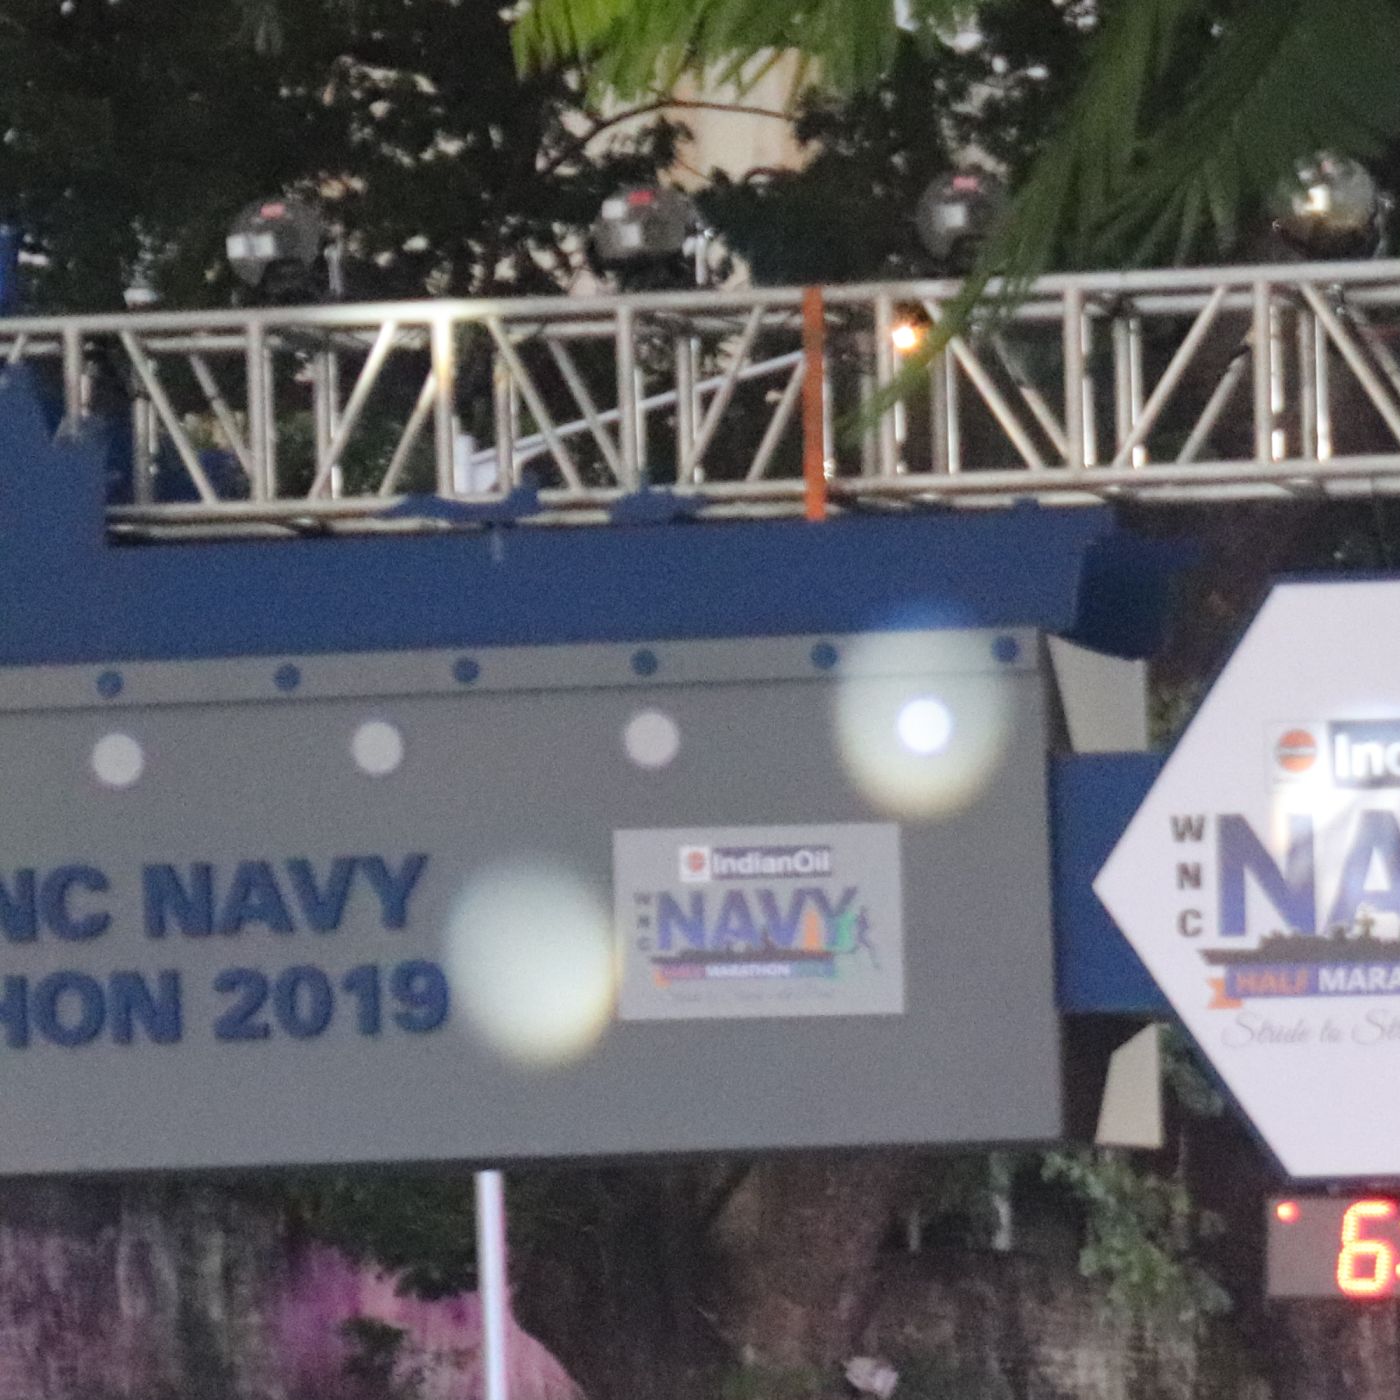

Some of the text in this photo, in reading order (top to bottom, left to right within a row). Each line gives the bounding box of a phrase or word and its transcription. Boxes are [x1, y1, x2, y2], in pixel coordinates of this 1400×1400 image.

[142, 854, 430, 938] NAVY
[712, 850, 830, 875] IndianOil
[657, 886, 858, 950] NAVY
[213, 960, 452, 1044] 2019
